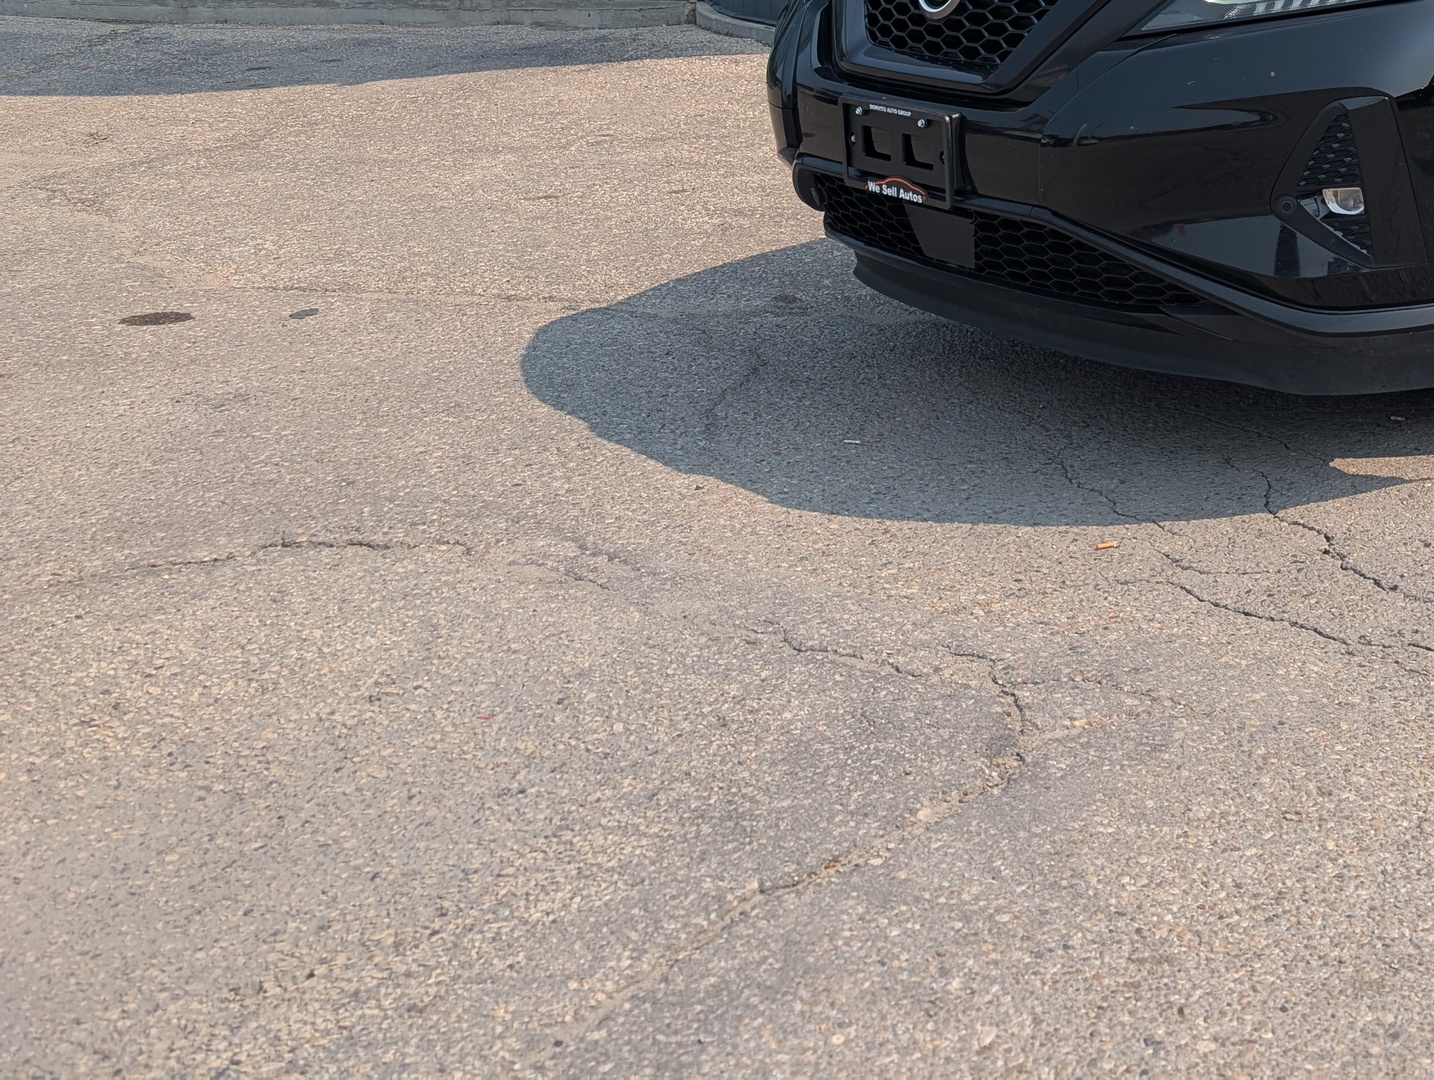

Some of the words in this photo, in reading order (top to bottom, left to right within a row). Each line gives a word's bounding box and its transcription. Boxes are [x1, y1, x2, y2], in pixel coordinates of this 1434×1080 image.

[867, 181, 880, 193] We
[882, 184, 898, 197] Sell
[899, 188, 923, 204] Autos
